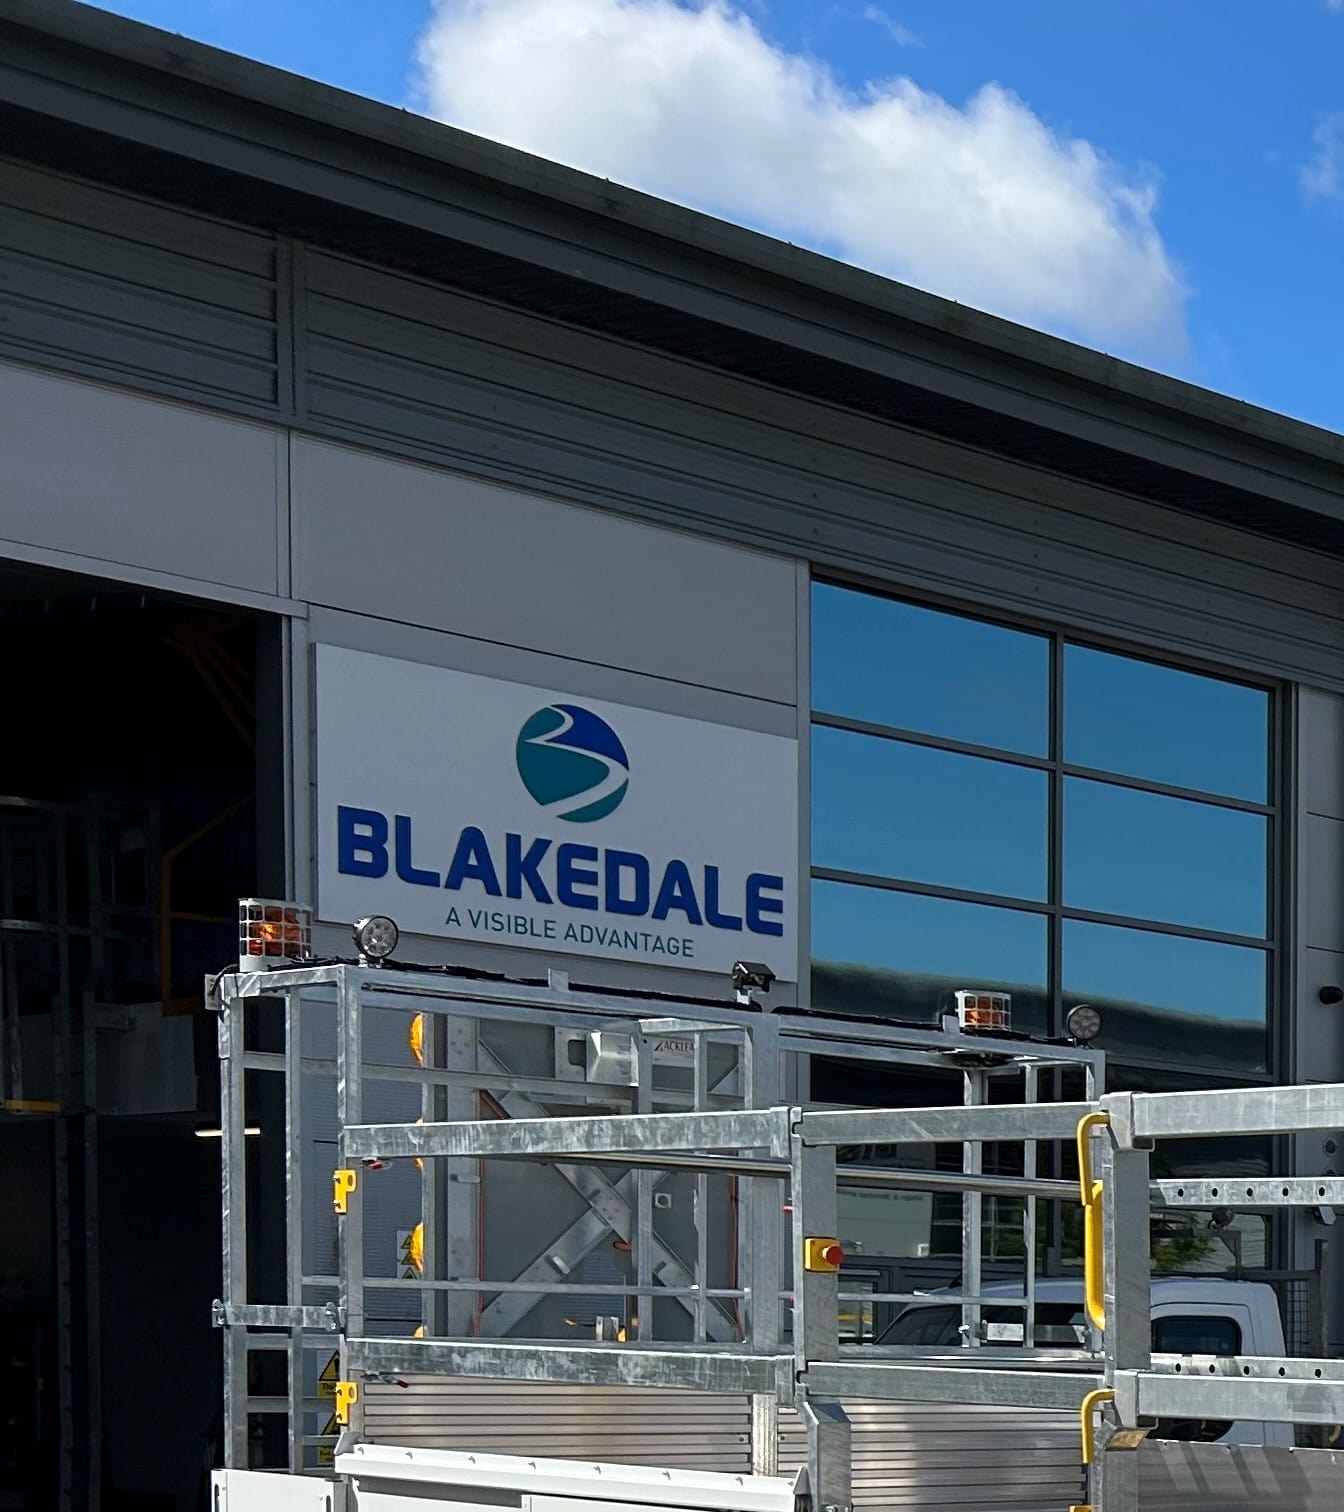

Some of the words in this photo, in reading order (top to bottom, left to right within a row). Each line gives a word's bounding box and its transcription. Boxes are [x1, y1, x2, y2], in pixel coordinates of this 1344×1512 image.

[337, 805, 784, 937] BLAKEDALE
[445, 906, 462, 928] A
[467, 908, 556, 939] VISIBLE
[564, 923, 694, 957] ADVANTAGE
